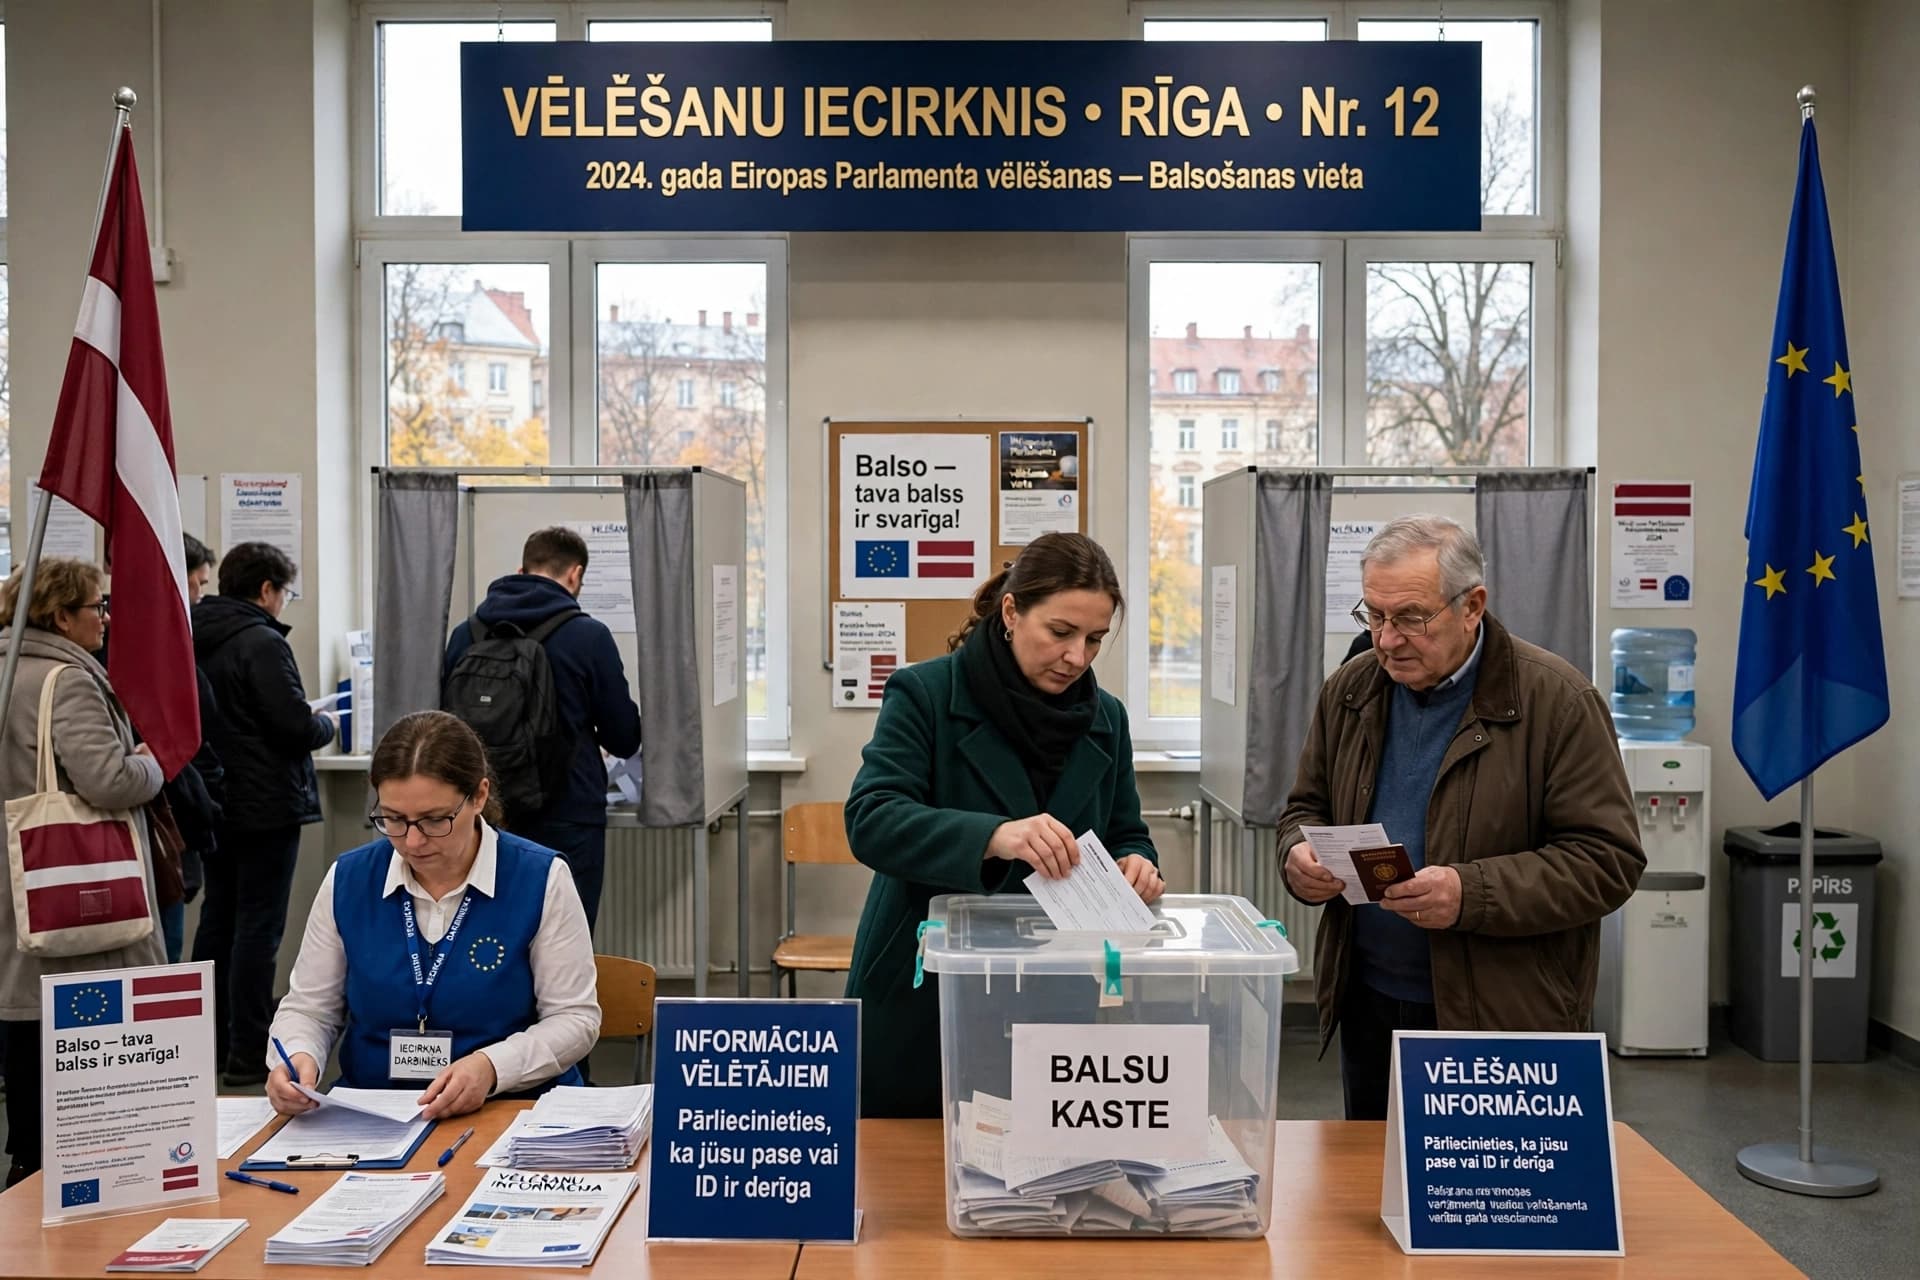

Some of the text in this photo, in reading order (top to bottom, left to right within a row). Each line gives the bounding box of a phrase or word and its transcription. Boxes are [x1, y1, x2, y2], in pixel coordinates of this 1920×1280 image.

[805, 86, 1066, 136] IECIRKNIS
[1122, 76, 1250, 136] RĪGA
[1302, 87, 1365, 136] Nr.
[1385, 87, 1438, 136] 12
[587, 161, 652, 189] 2024.
[661, 162, 722, 196] gada
[731, 162, 827, 195] Eiropas
[836, 162, 978, 188] Parlamenta
[1150, 161, 1295, 189] Balsošanas
[1303, 162, 1363, 188] vieta
[856, 455, 927, 477] Balso
[855, 483, 963, 503] tava balss
[856, 509, 959, 533] ir svarīga!
[1787, 875, 1853, 894] PPĪRS
[56, 1038, 100, 1054] Balso
[122, 1034, 153, 1047] tava
[676, 1026, 838, 1052] INFORMĀCIJA
[56, 1044, 179, 1072] balss ir svarīga!
[394, 1056, 448, 1067] DARBINIEKS
[1051, 1055, 1168, 1083] BALSU
[1425, 1057, 1557, 1085] VĒLĒŠANU
[682, 1059, 828, 1087] VĒLĒTĀJIEM
[1052, 1100, 1169, 1128] KASTE
[1425, 1090, 1583, 1116] INFORMĀCIJA
[679, 1109, 831, 1135] Pārliecinieties,
[670, 1141, 693, 1163] ka
[752, 1148, 801, 1169] pase
[808, 1143, 838, 1164] vai
[1424, 1136, 1517, 1152] Pārliecinieties,
[1521, 1137, 1536, 1150] ka
[1426, 1155, 1554, 1172] pase vai ID ir derīga
[696, 1175, 810, 1203] ID ir derīga
